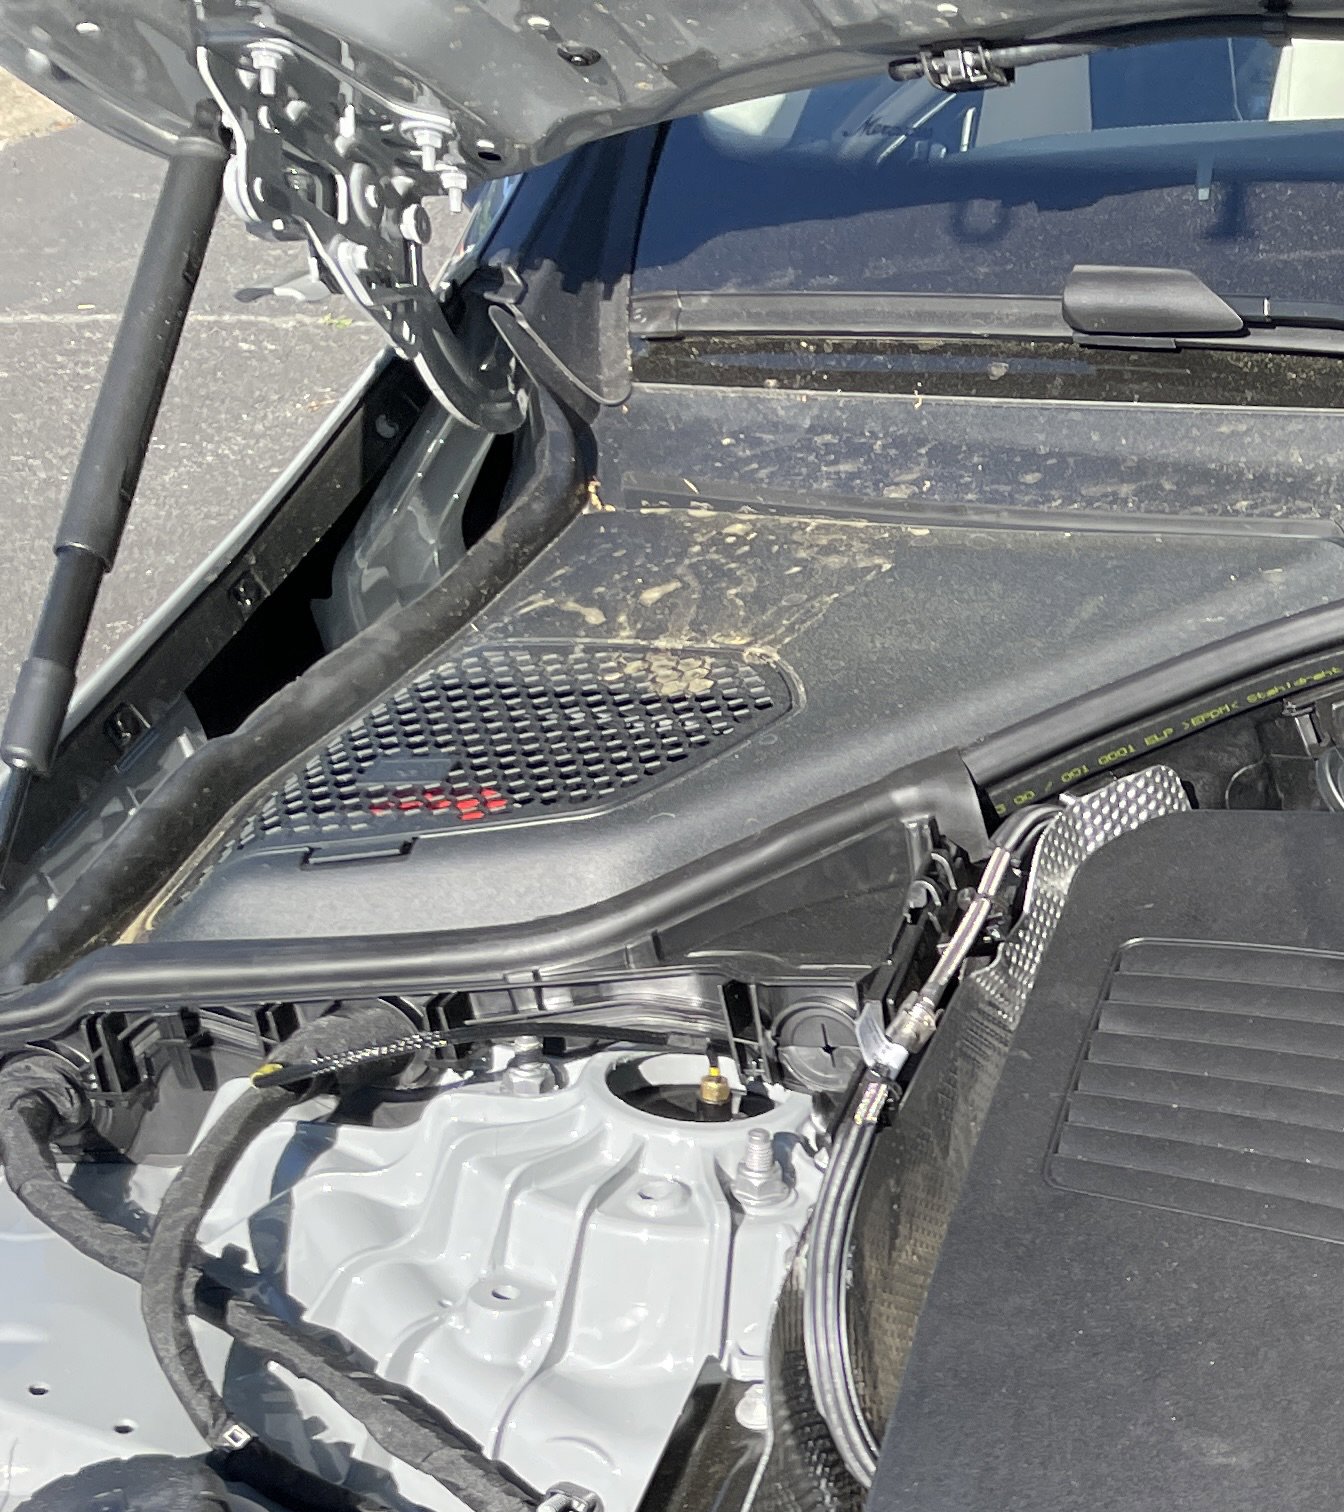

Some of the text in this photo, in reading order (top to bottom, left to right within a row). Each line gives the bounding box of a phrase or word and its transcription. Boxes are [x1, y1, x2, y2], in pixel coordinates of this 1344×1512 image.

[1013, 789, 1036, 805] 00
[1060, 764, 1090, 784] 001
[1097, 743, 1137, 766] 0001
[1143, 726, 1174, 747] ELP
